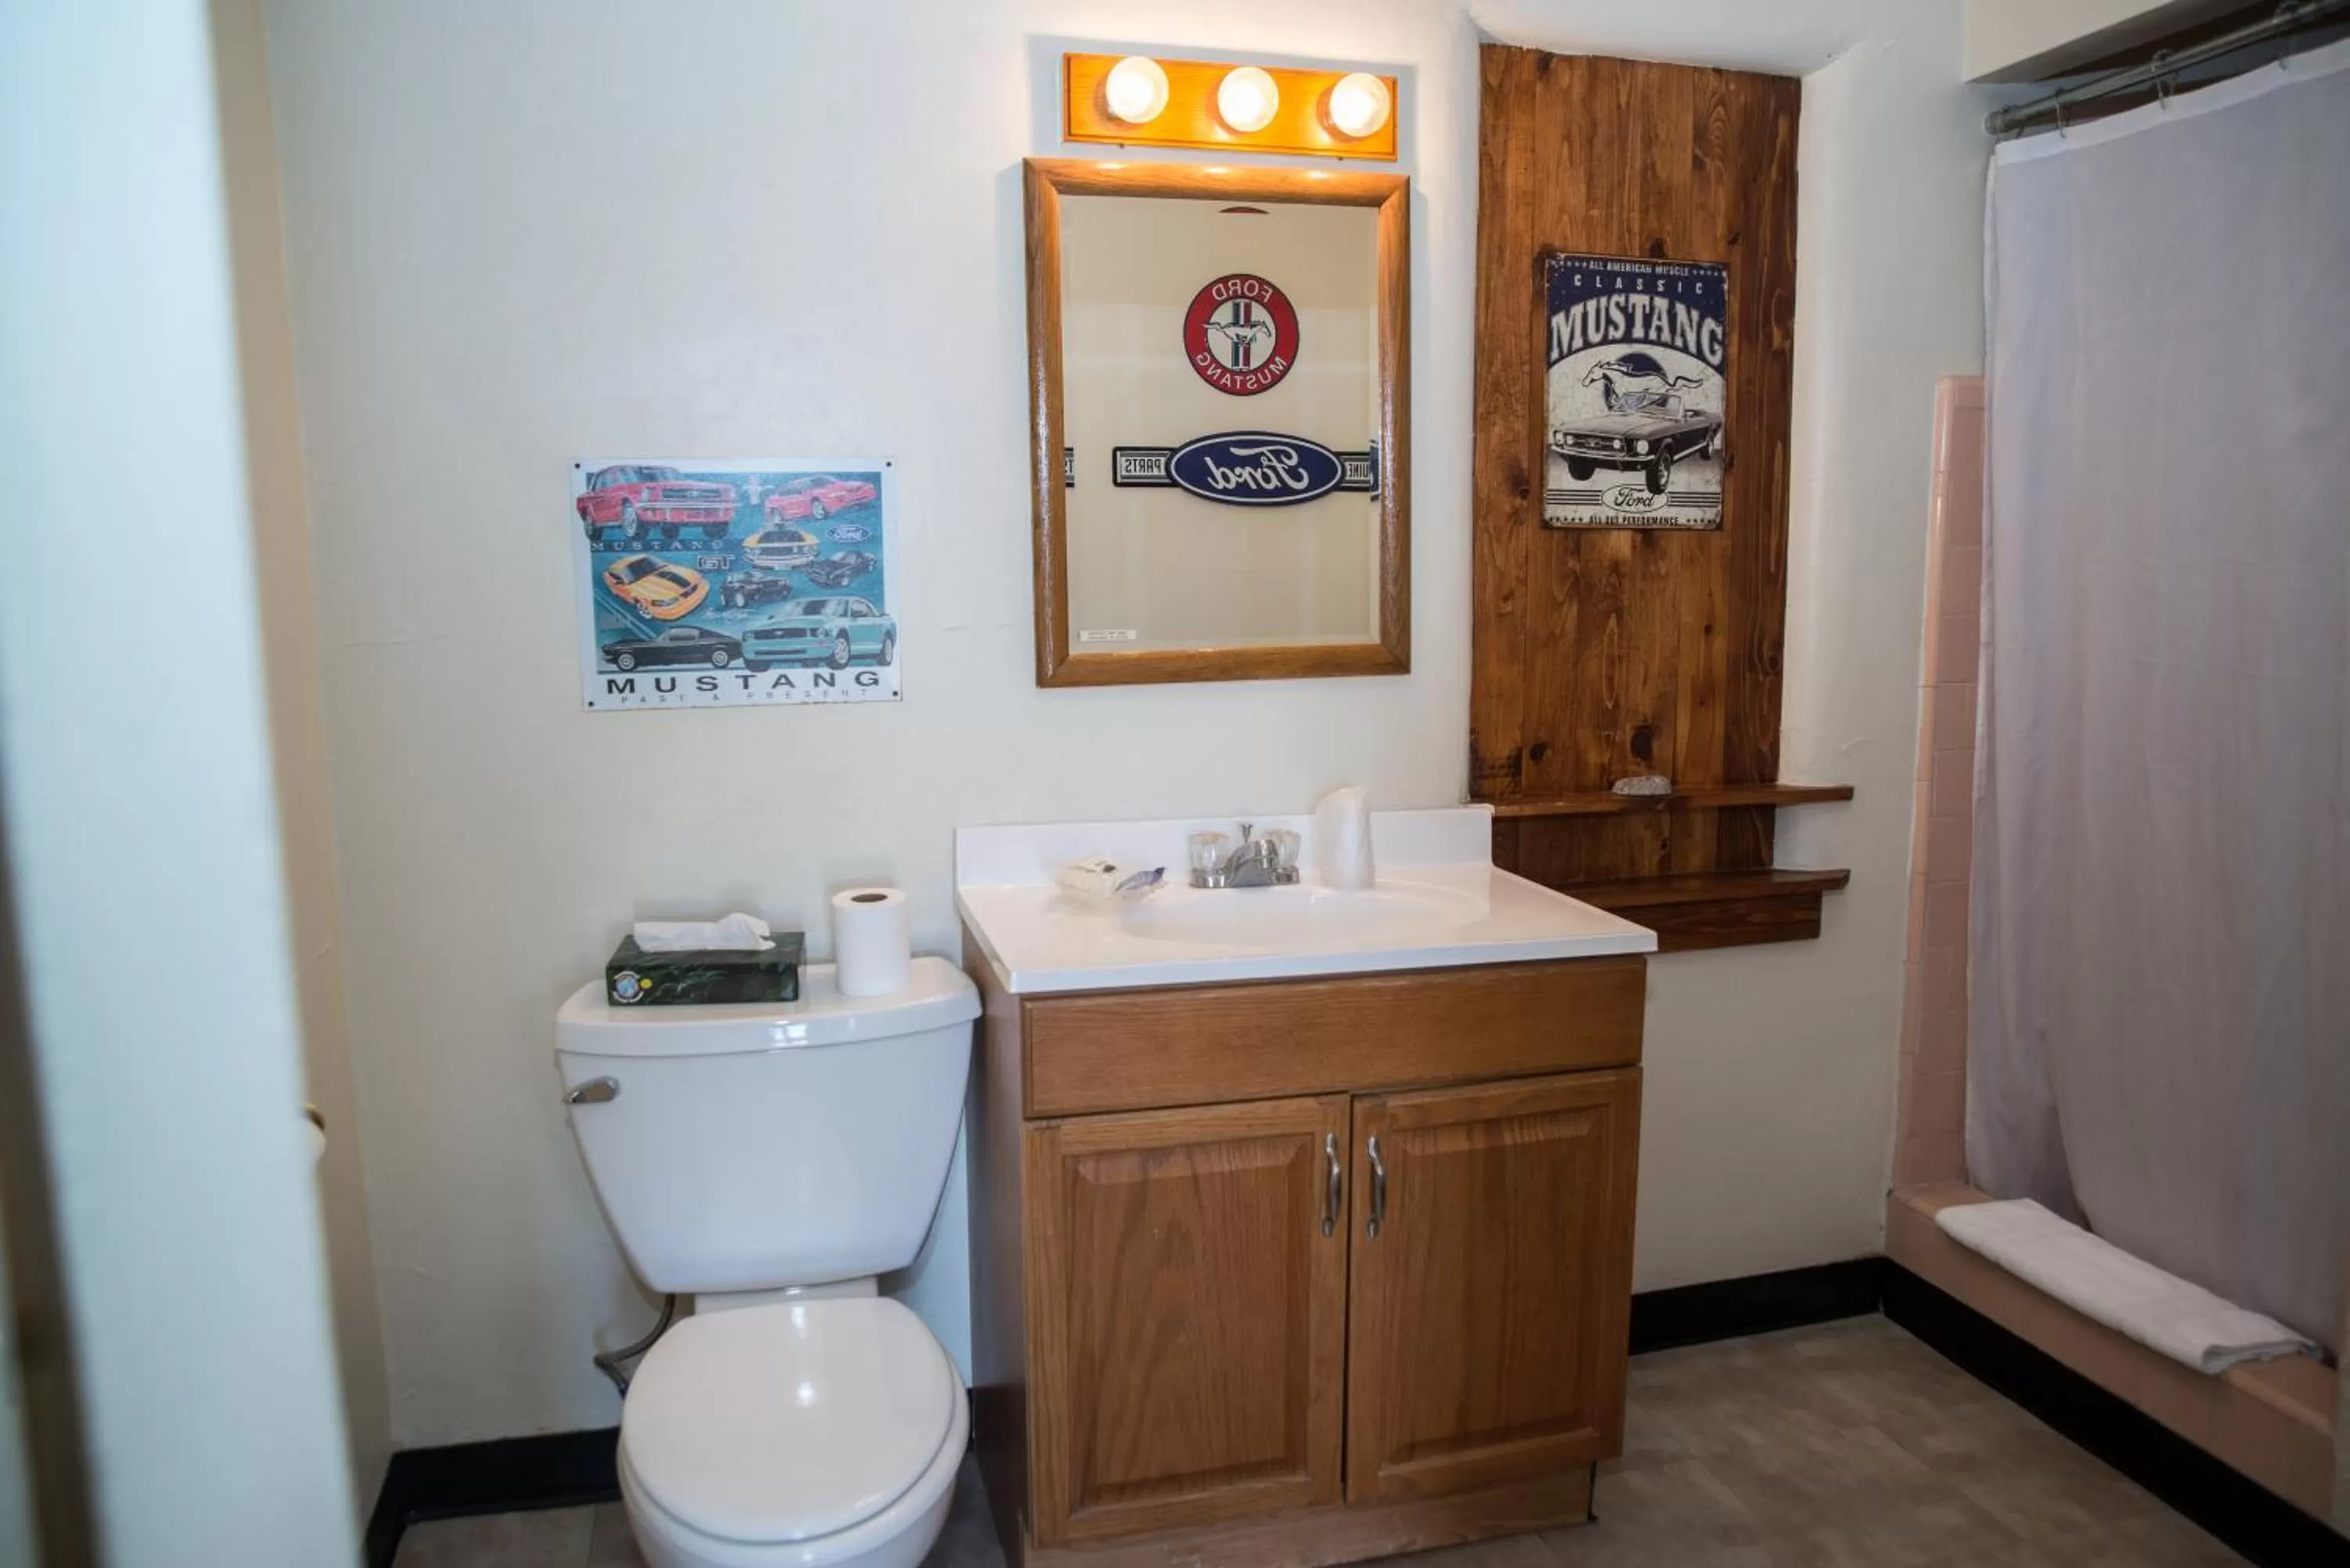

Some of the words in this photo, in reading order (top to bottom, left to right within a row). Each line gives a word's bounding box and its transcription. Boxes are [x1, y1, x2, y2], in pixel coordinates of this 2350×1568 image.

[1589, 261, 1604, 270] ALL
[1607, 261, 1652, 273] AMERICAN
[1655, 264, 1690, 276] MUSCLE
[1574, 274, 1703, 294] CLASSIC
[1550, 293, 1723, 367] MUSTANG
[1614, 486, 1654, 507] Ford
[591, 540, 723, 551] MUSTANG
[606, 670, 880, 695] MUSTANG
